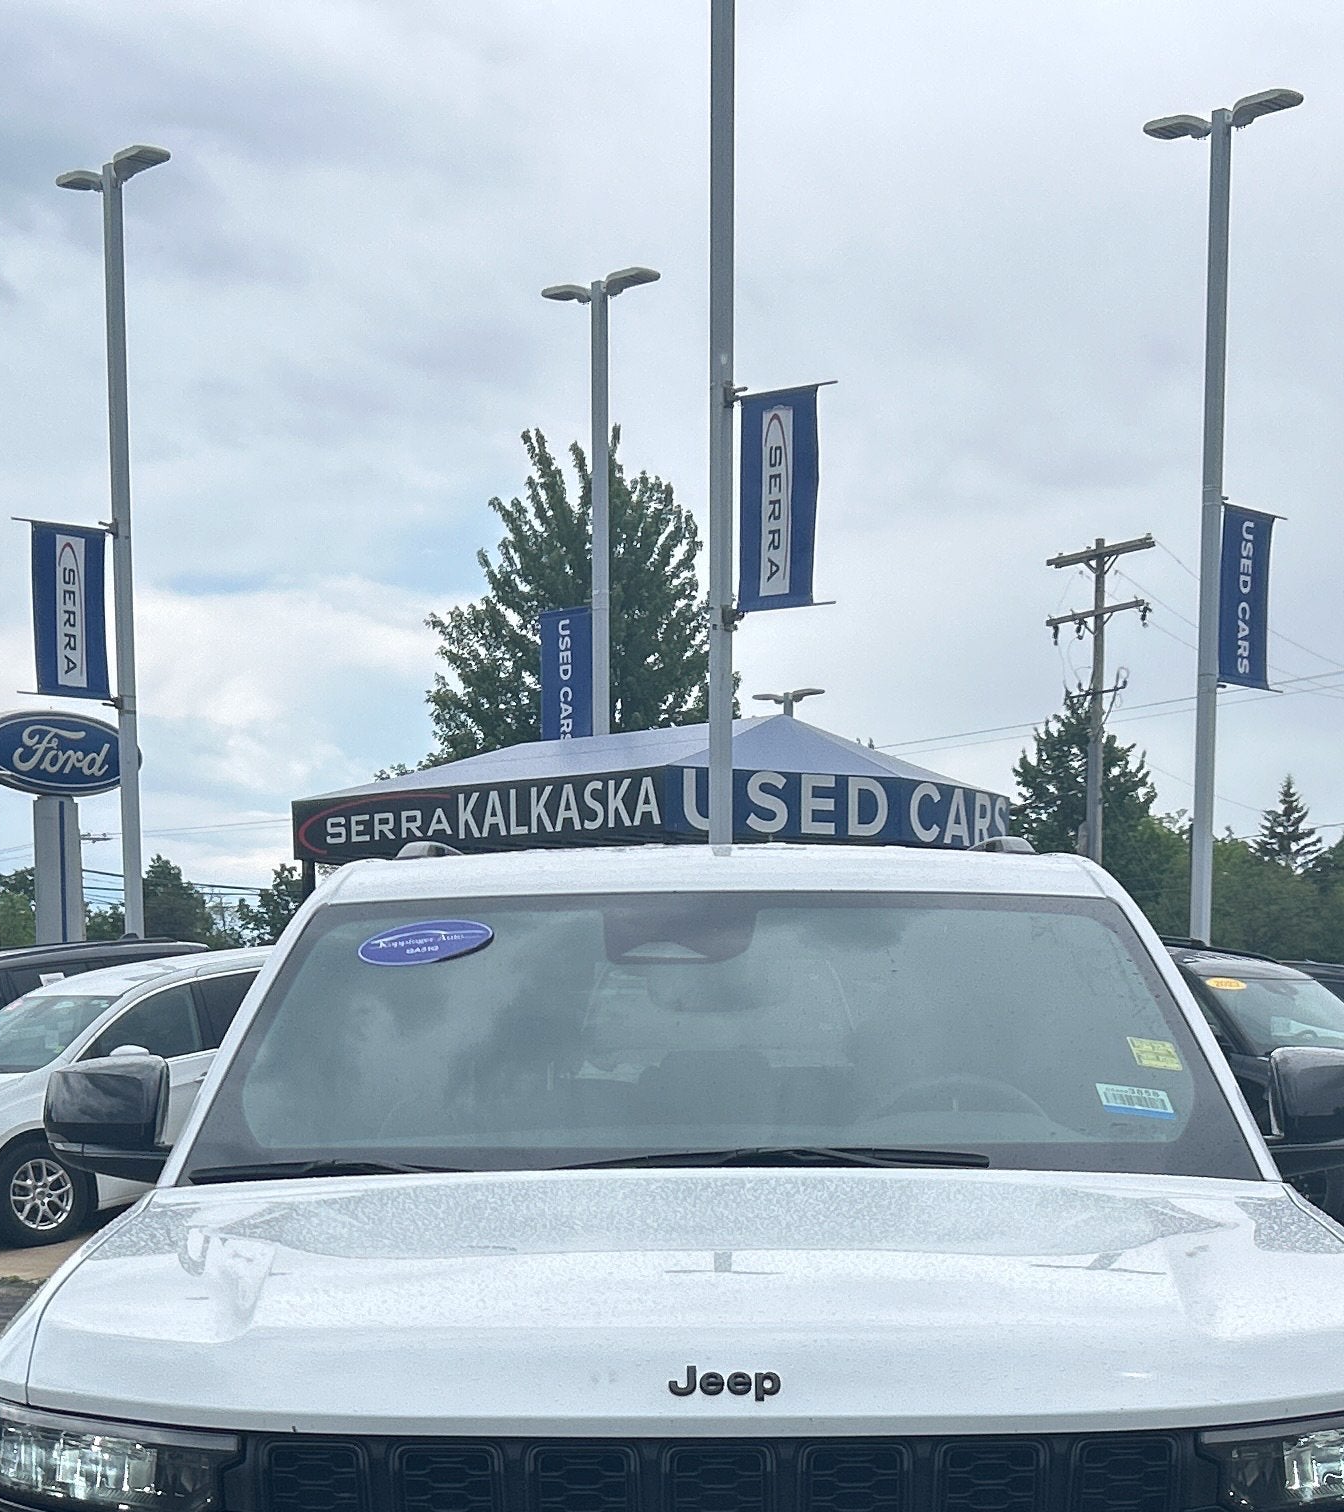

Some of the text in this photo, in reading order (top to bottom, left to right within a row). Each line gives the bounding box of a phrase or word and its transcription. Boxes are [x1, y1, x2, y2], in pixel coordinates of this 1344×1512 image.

[767, 445, 782, 583] SERRA
[62, 566, 77, 675] SERRA
[1237, 520, 1255, 674] USED CARS
[558, 619, 572, 681] USED
[12, 725, 110, 776] Ford
[325, 776, 662, 844] SERRA KALKASKA
[682, 768, 1007, 846] USED CARS
[668, 1365, 781, 1402] Jeep
